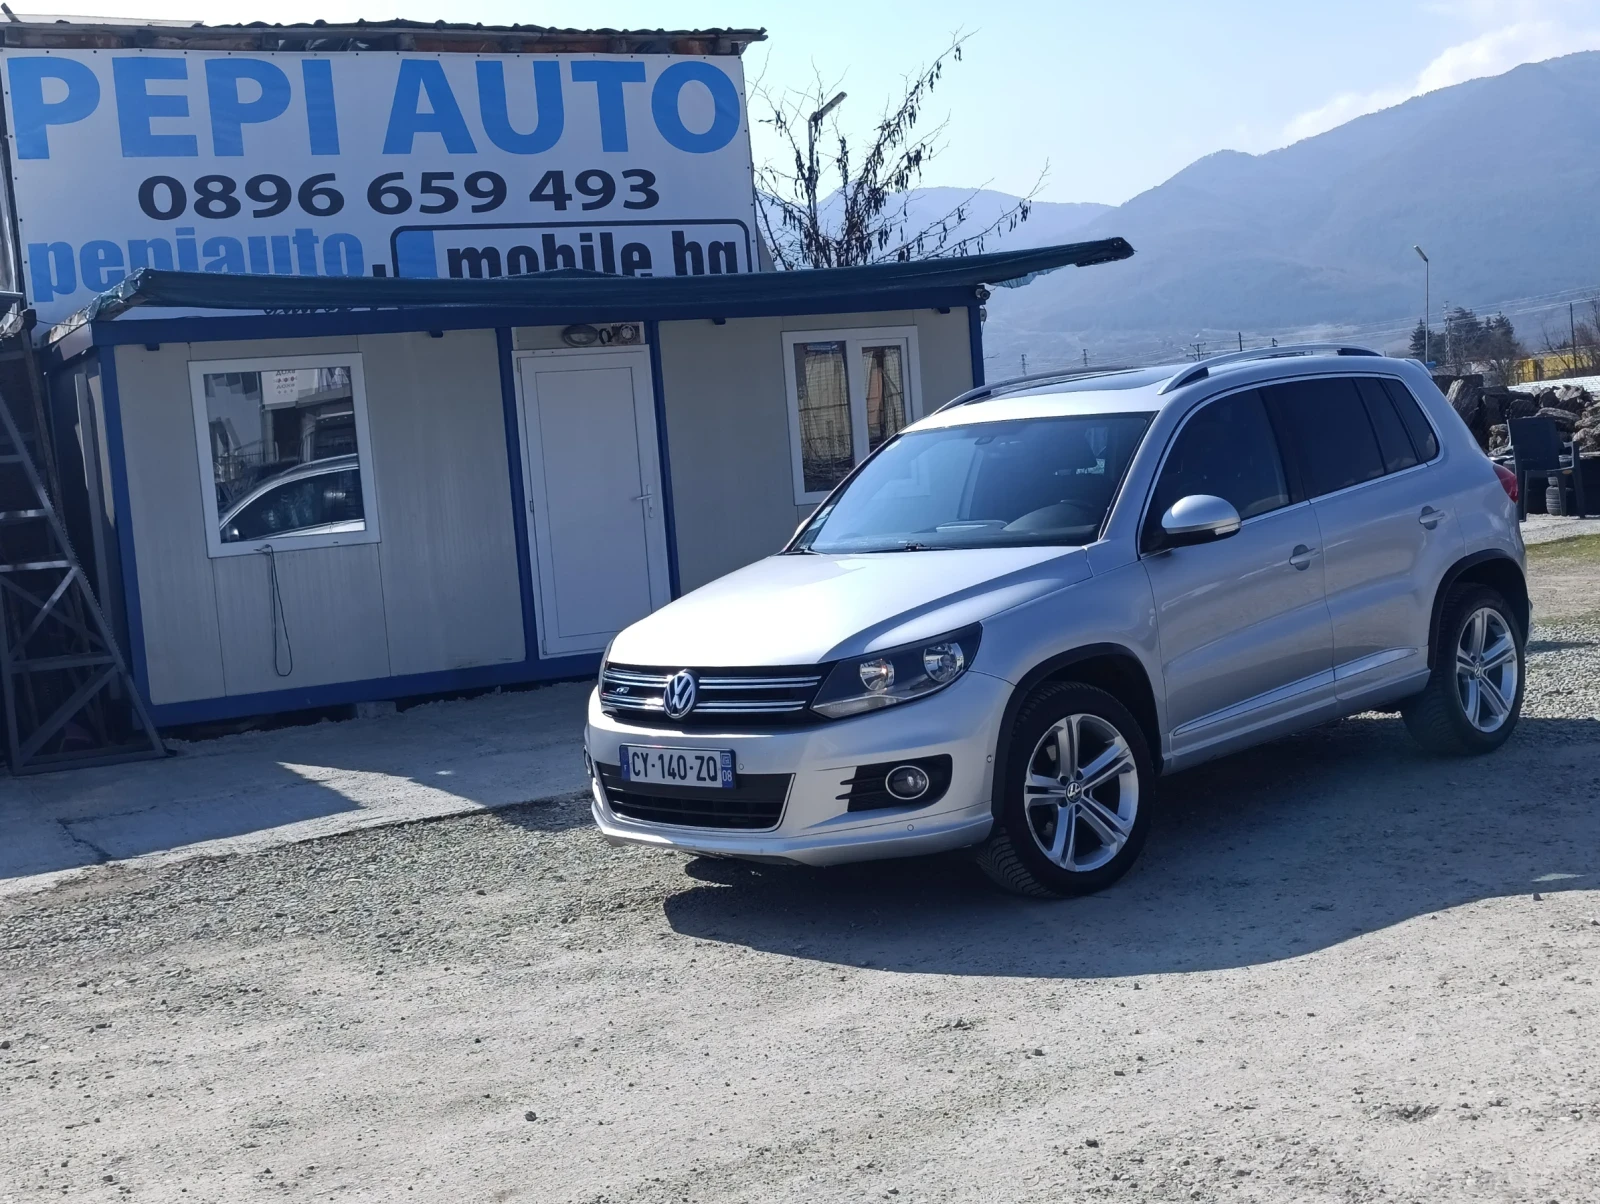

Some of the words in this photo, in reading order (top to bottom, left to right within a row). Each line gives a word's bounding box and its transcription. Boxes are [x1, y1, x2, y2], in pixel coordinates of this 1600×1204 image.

[6, 57, 341, 159] PEPI
[382, 58, 741, 155] AUTO
[138, 173, 345, 221] 0896
[367, 170, 507, 215] 659
[529, 168, 660, 212] 493
[722, 769, 733, 781] 08
